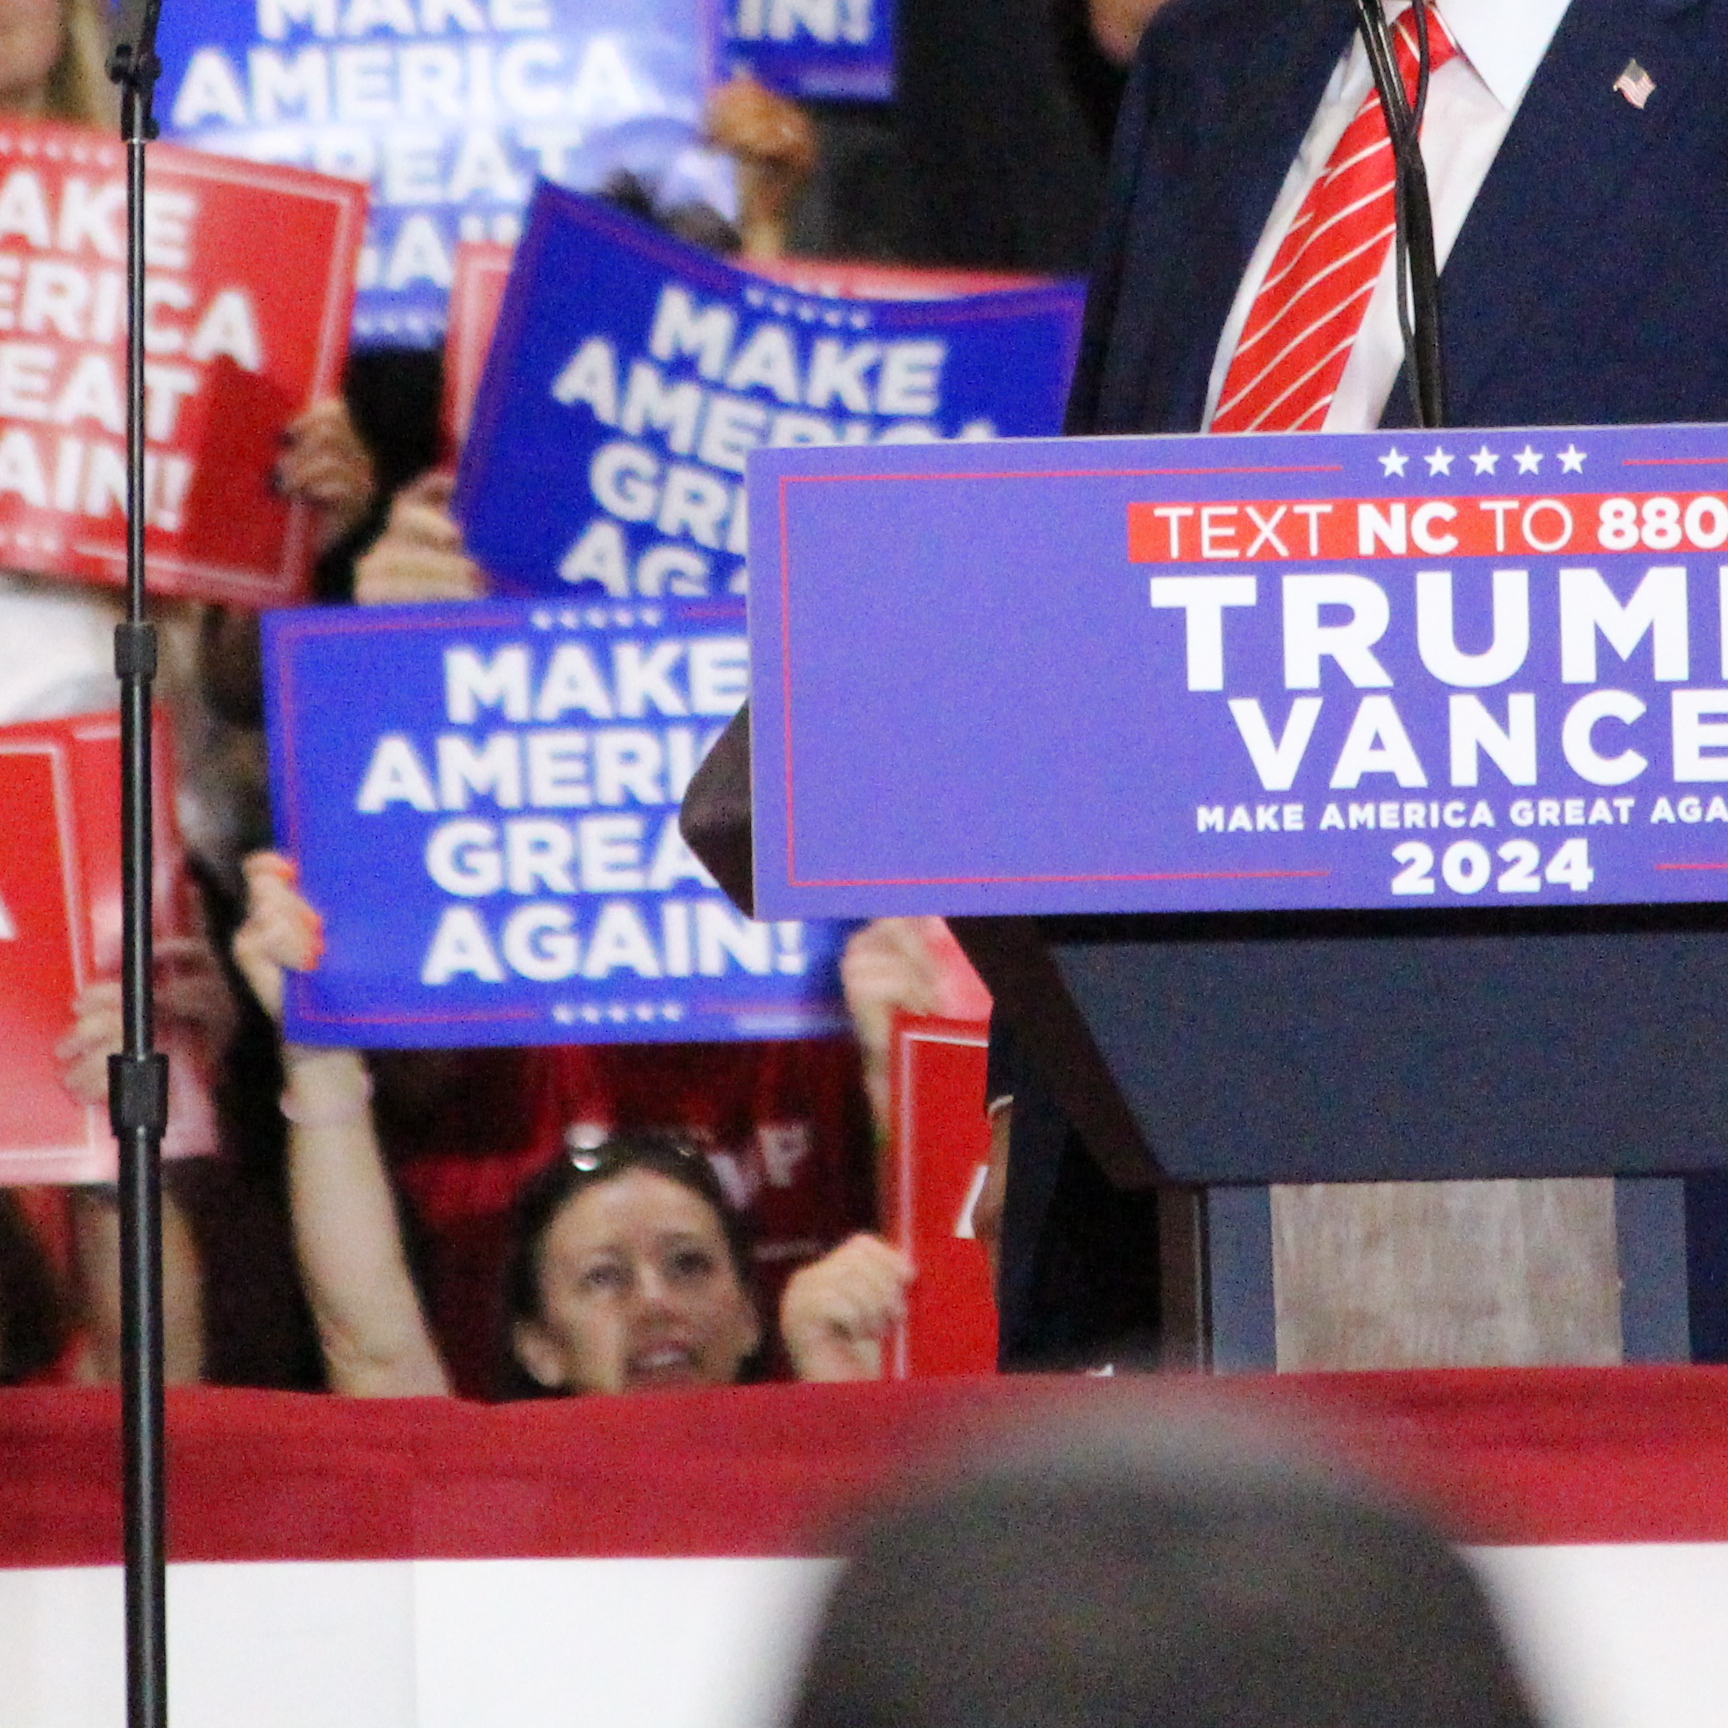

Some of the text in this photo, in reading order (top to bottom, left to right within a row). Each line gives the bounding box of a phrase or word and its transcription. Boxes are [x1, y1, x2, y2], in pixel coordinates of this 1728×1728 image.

[171, 35, 639, 128] AMERICA
[649, 284, 946, 417] MAKE
[1153, 504, 1332, 559] TEXT
[1358, 501, 1459, 555] NC
[1479, 499, 1573, 553] TO
[443, 636, 748, 725] MAKE
[357, 728, 719, 814] AMERI
[1196, 803, 1305, 832] MAKE
[1319, 799, 1494, 830] AMERICA
[1509, 798, 1634, 828] GREAT
[1391, 838, 1594, 896] 2024
[421, 897, 806, 984] AGAIN!
